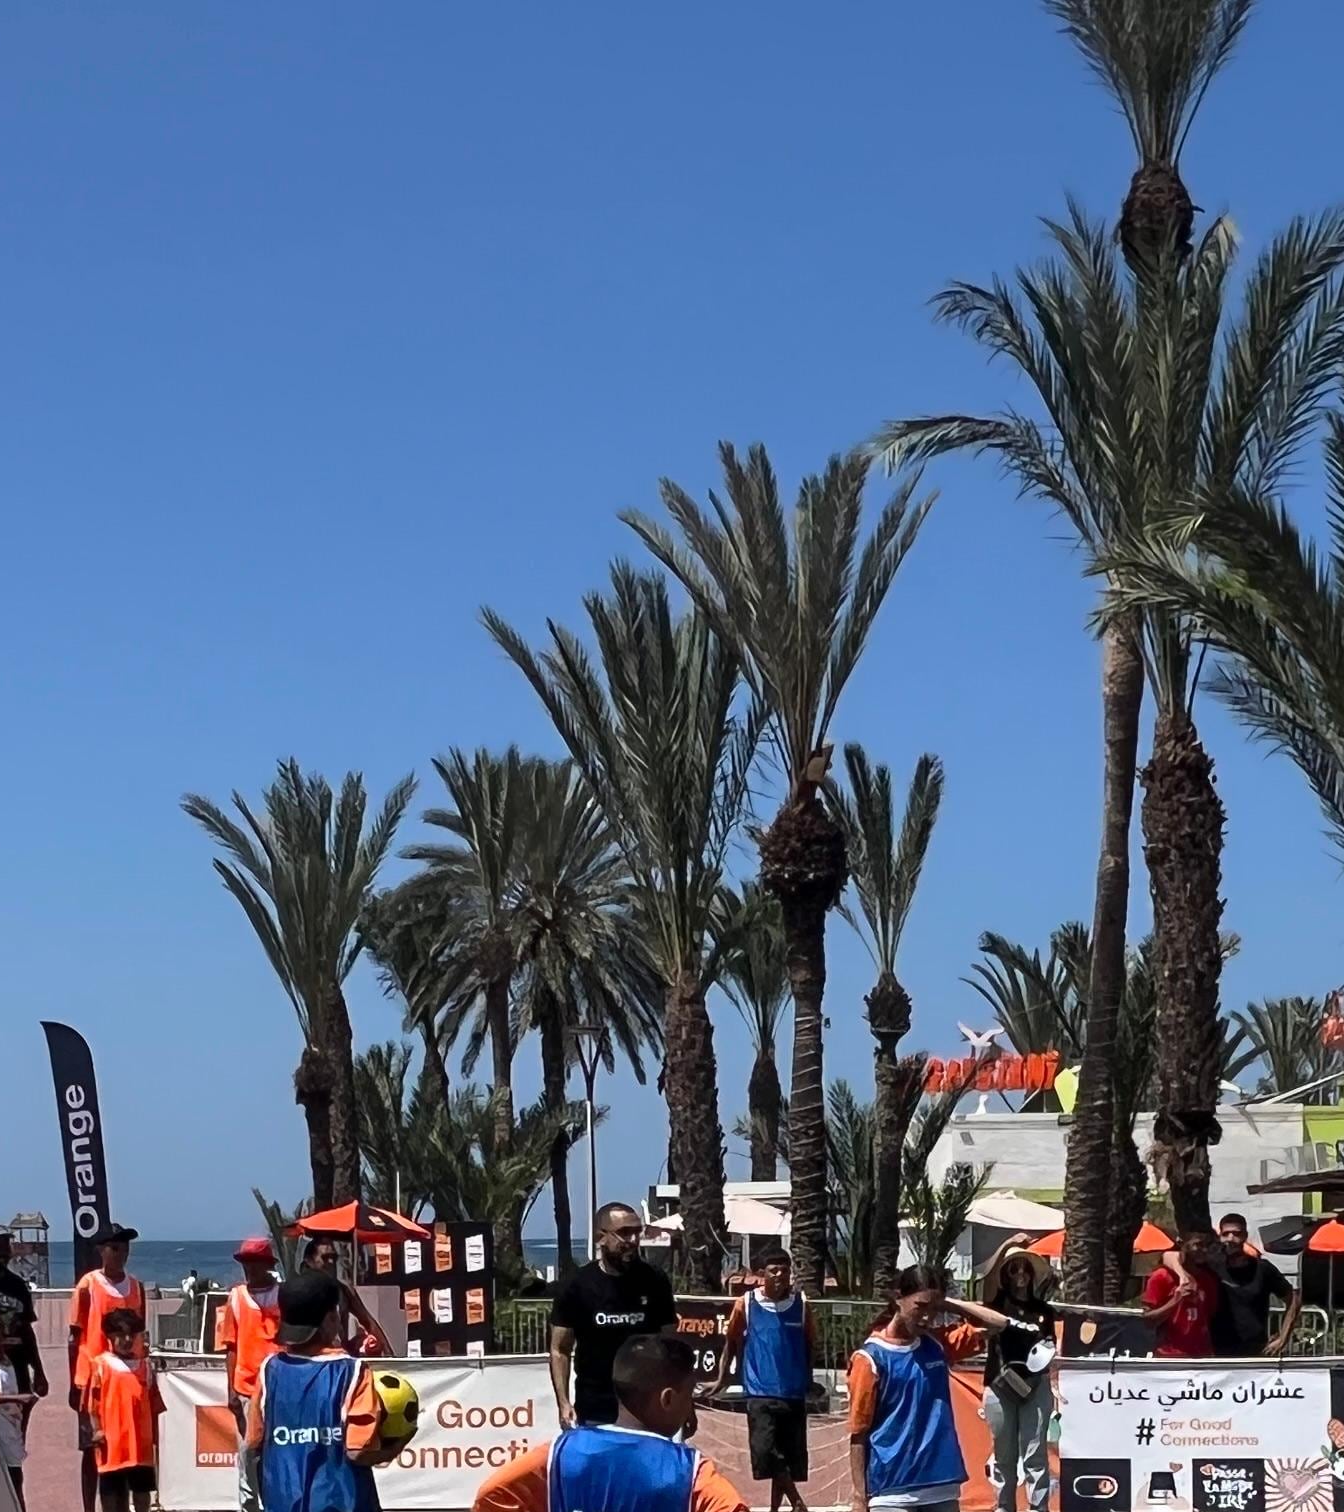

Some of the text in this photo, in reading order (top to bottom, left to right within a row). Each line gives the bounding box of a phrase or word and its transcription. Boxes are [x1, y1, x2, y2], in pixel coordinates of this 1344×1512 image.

[66, 1084, 100, 1238] Orange
[1089, 1377, 1305, 1412] عشران ماشي عديان
[436, 1399, 534, 1429] Good
[1160, 1418, 1183, 1431] For
[1190, 1418, 1233, 1431] Good
[273, 1426, 343, 1446] Orange
[1160, 1433, 1259, 1446] Connections
[197, 1451, 240, 1468] oran
[376, 1438, 528, 1468] onnecti
